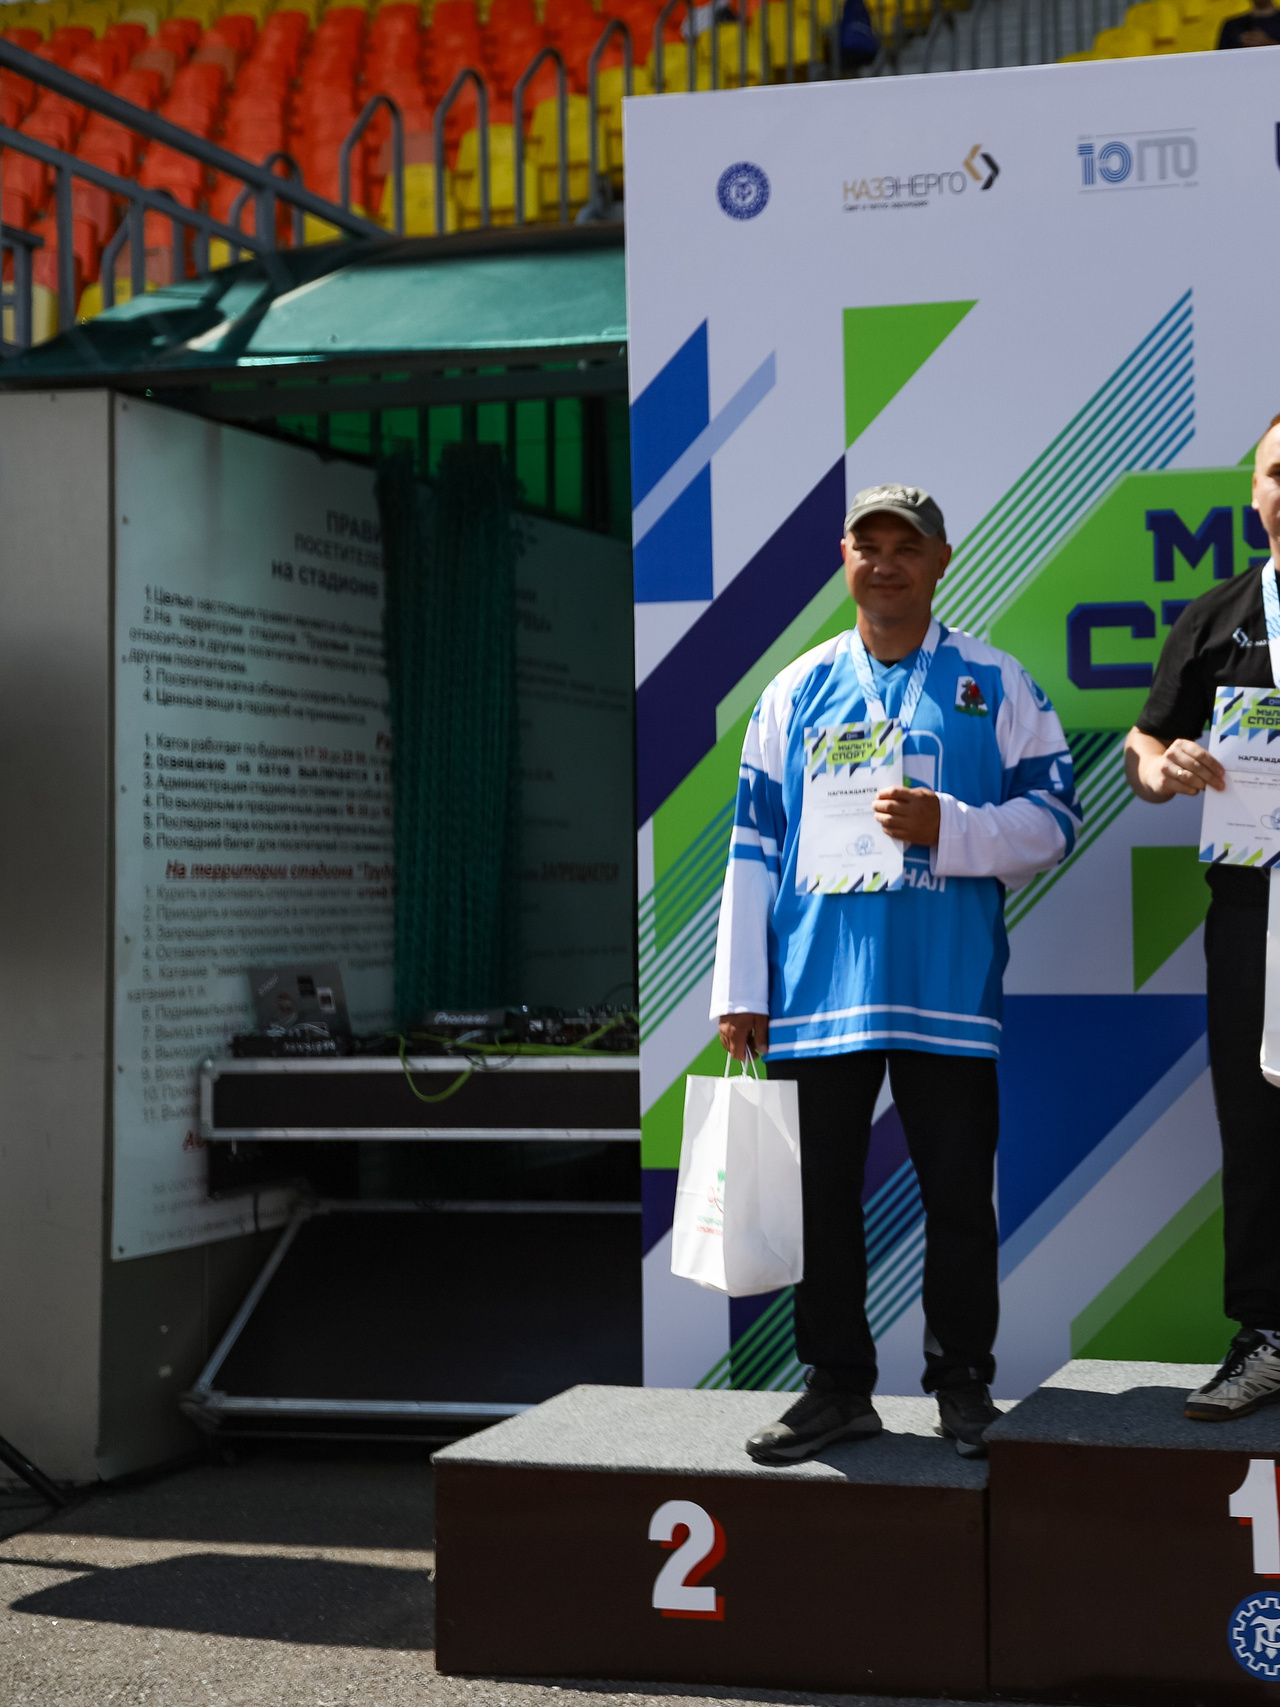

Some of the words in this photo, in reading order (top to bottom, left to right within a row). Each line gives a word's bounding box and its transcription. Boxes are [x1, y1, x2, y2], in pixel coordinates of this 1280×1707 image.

[842, 171, 968, 201] КАЗЭНЕРГО
[832, 750, 866, 761] СПОРТ
[648, 1500, 724, 1621] 2
